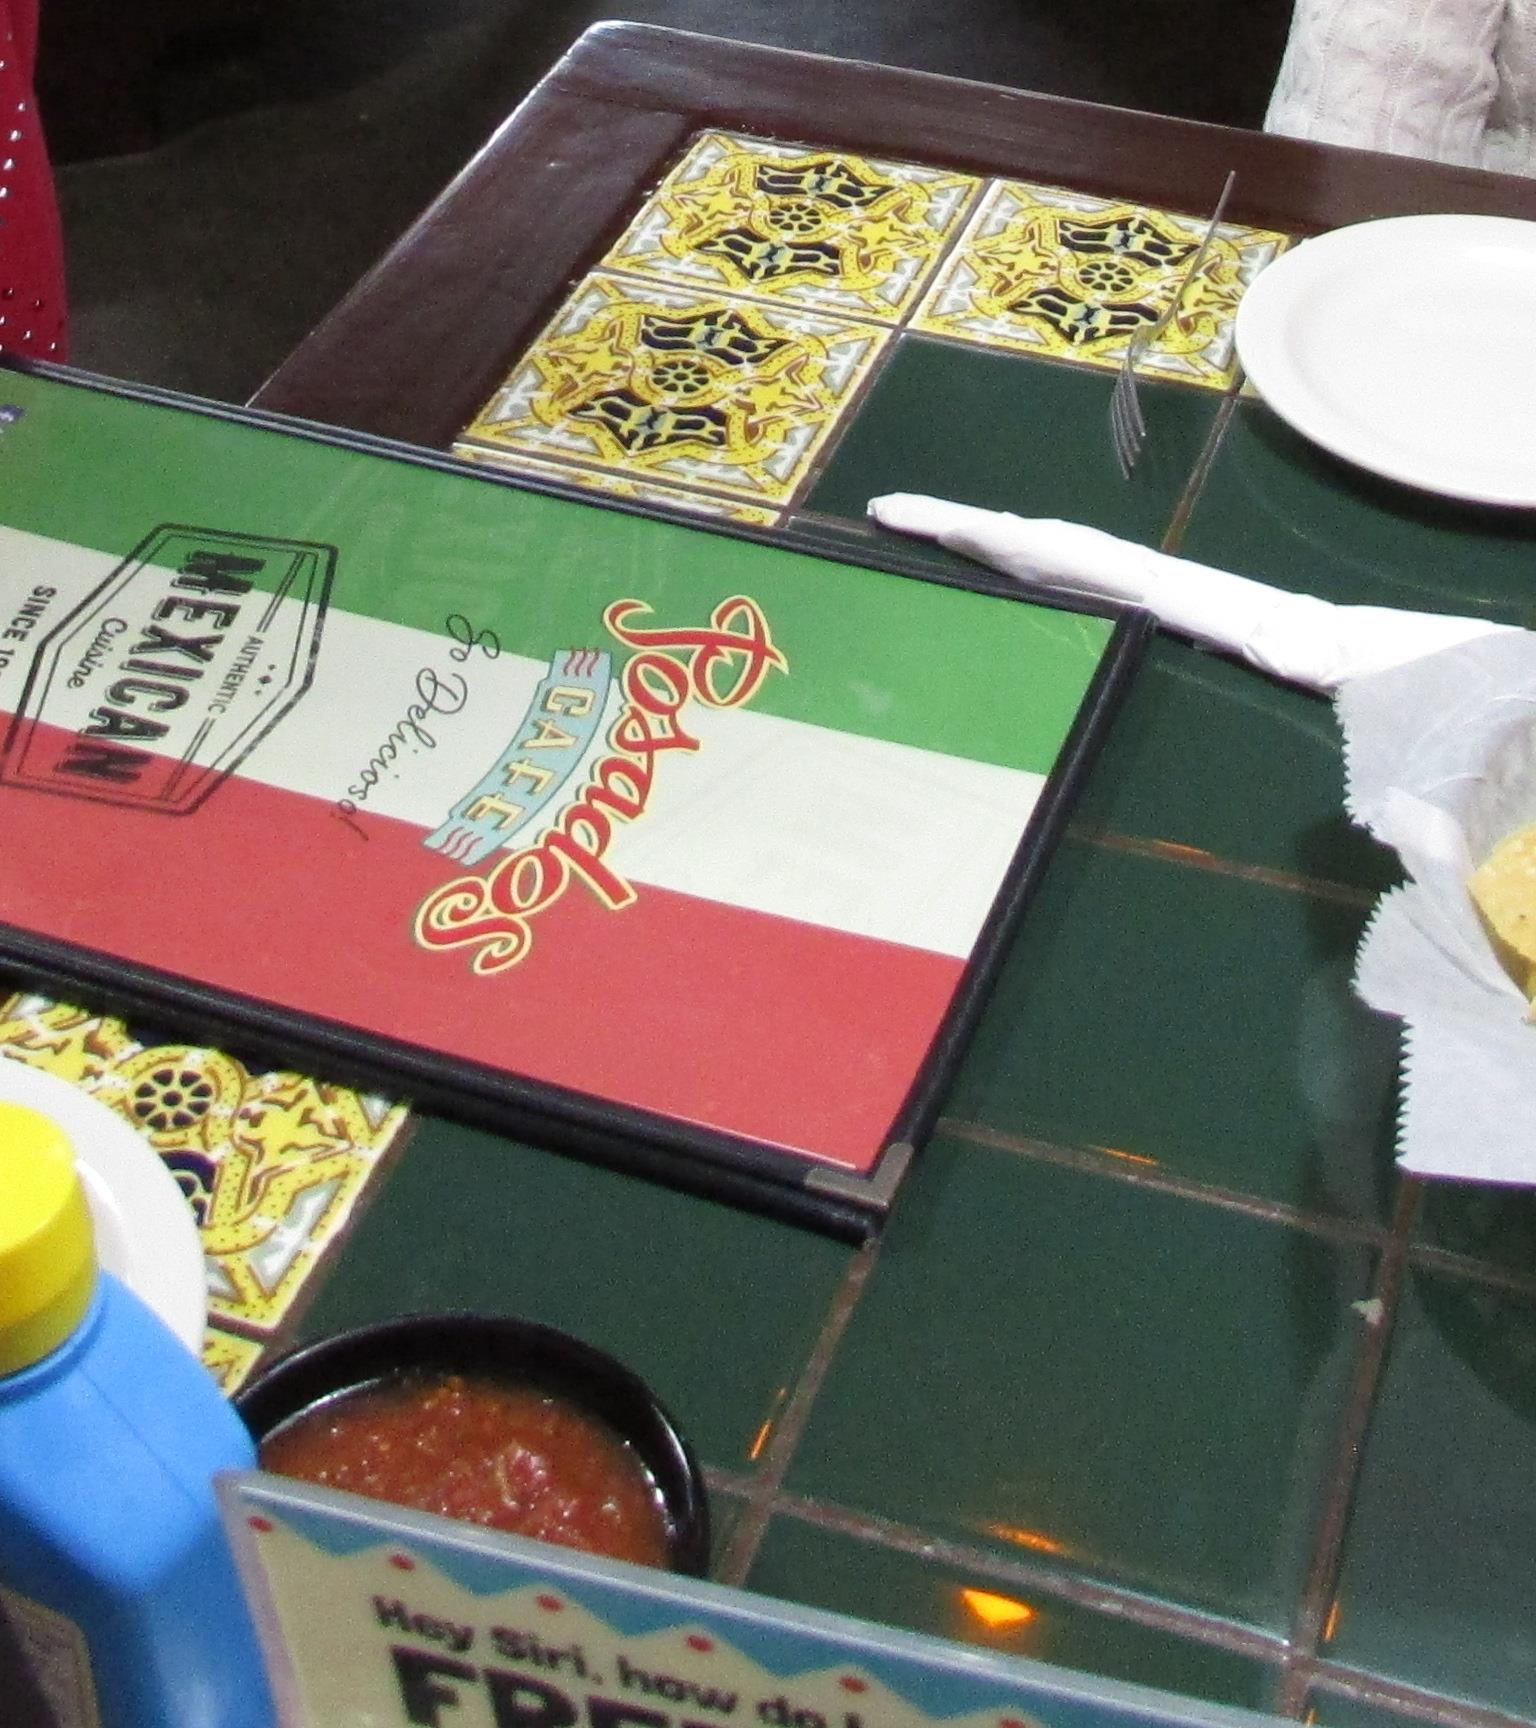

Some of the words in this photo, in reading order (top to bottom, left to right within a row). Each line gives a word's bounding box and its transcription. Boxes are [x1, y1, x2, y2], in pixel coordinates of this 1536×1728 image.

[1, 585, 56, 642] SINCE
[55, 551, 267, 786] MEXICAN
[66, 618, 128, 690] Cuisine
[210, 635, 265, 716] AUTHENTIC
[414, 595, 789, 975] Posados
[466, 685, 593, 829] CAFE
[373, 1594, 475, 1654] Hey
[616, 1653, 741, 1719] how
